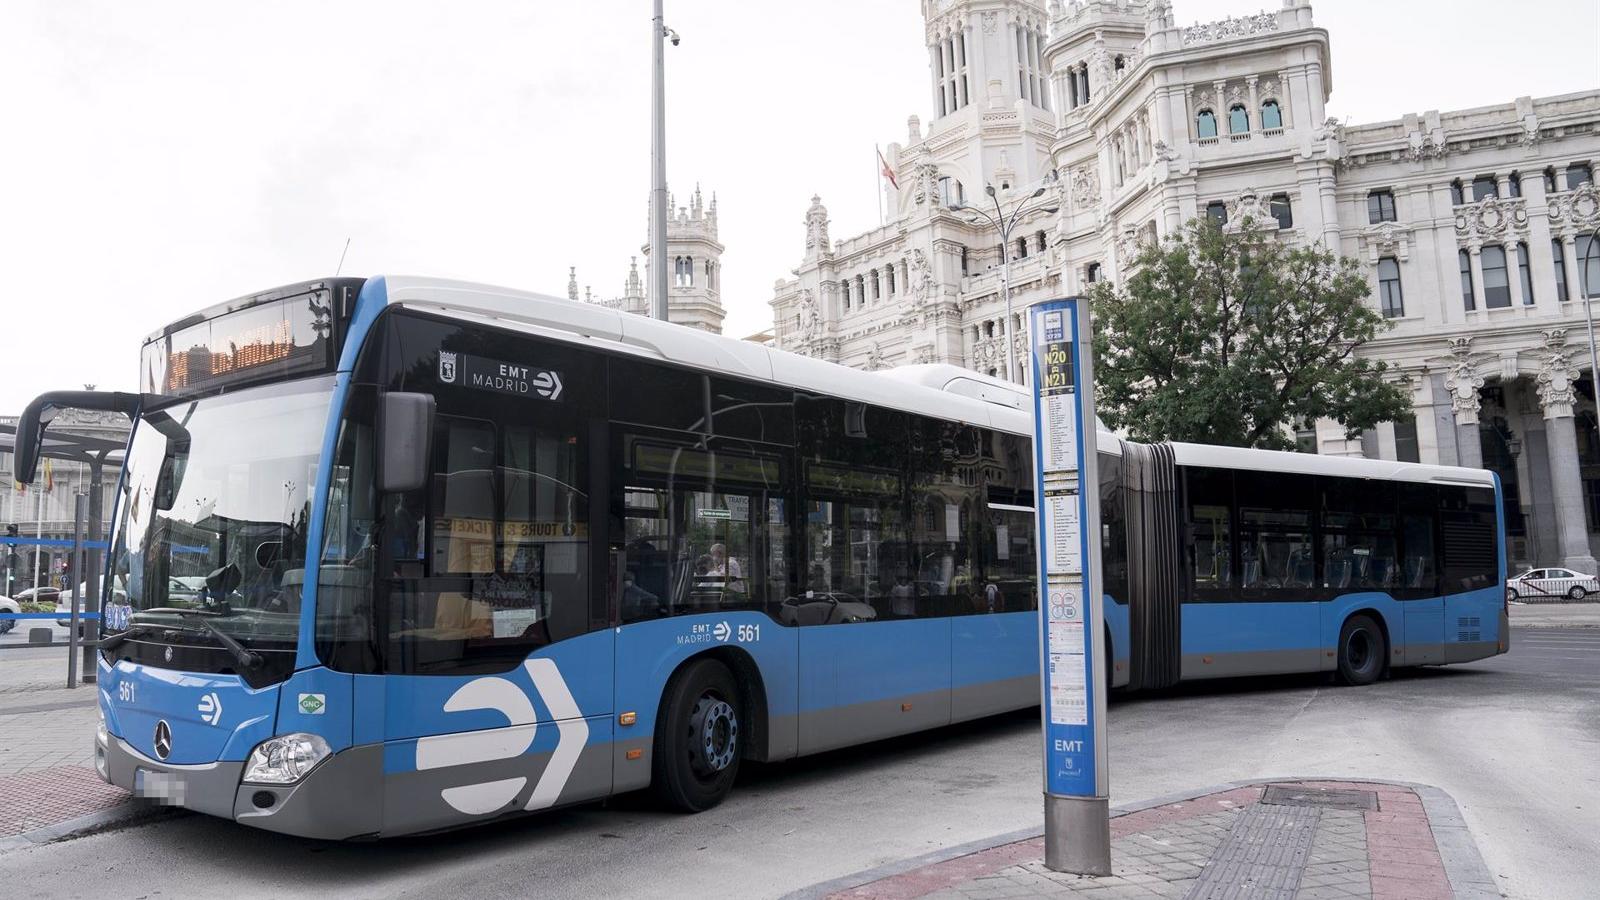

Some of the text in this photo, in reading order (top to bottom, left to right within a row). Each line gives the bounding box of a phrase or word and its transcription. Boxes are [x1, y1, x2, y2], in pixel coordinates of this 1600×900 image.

[1044, 350, 1066, 365] N20
[499, 364, 529, 380] EMT
[473, 373, 529, 393] MADRID
[1045, 373, 1066, 388] N21
[677, 633, 711, 645] MADRID
[692, 623, 760, 642] EMT 561
[119, 680, 135, 703] 561
[302, 700, 320, 709] GNC
[1054, 739, 1084, 753] EMT
